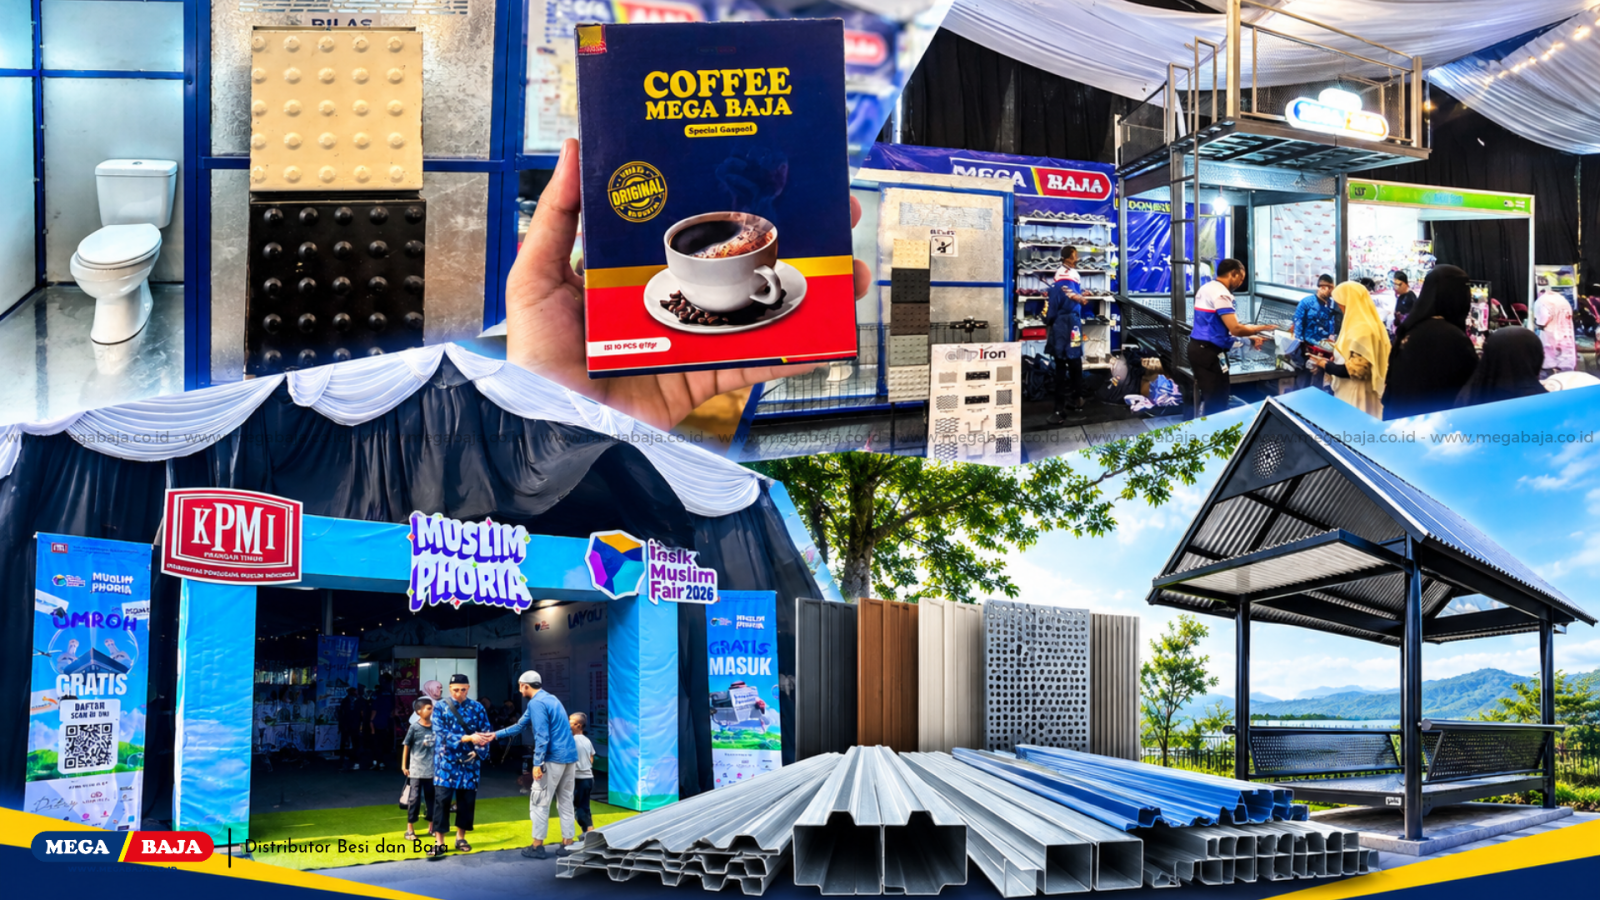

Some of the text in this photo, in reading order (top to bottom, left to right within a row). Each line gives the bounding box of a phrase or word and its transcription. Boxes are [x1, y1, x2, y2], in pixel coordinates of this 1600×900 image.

[643, 66, 792, 99] COFFEE
[645, 96, 793, 120] MEGA BAJA
[688, 126, 718, 136] Special
[611, 178, 664, 206] ORIGINAL
[1047, 174, 1104, 193] BAJA
[623, 342, 638, 350] PCS
[191, 502, 276, 555] KPMI
[411, 513, 527, 564] MUSLIM
[410, 559, 532, 611] PHORIA
[650, 563, 715, 585] Muslim
[91, 583, 132, 595] PHORIA
[650, 580, 714, 601] Fair 2026
[52, 610, 138, 632] UMROH
[709, 640, 772, 655] GRATIS
[709, 656, 772, 676] MASUK
[56, 672, 128, 696] GRATIS
[75, 701, 105, 711] DAFTAR
